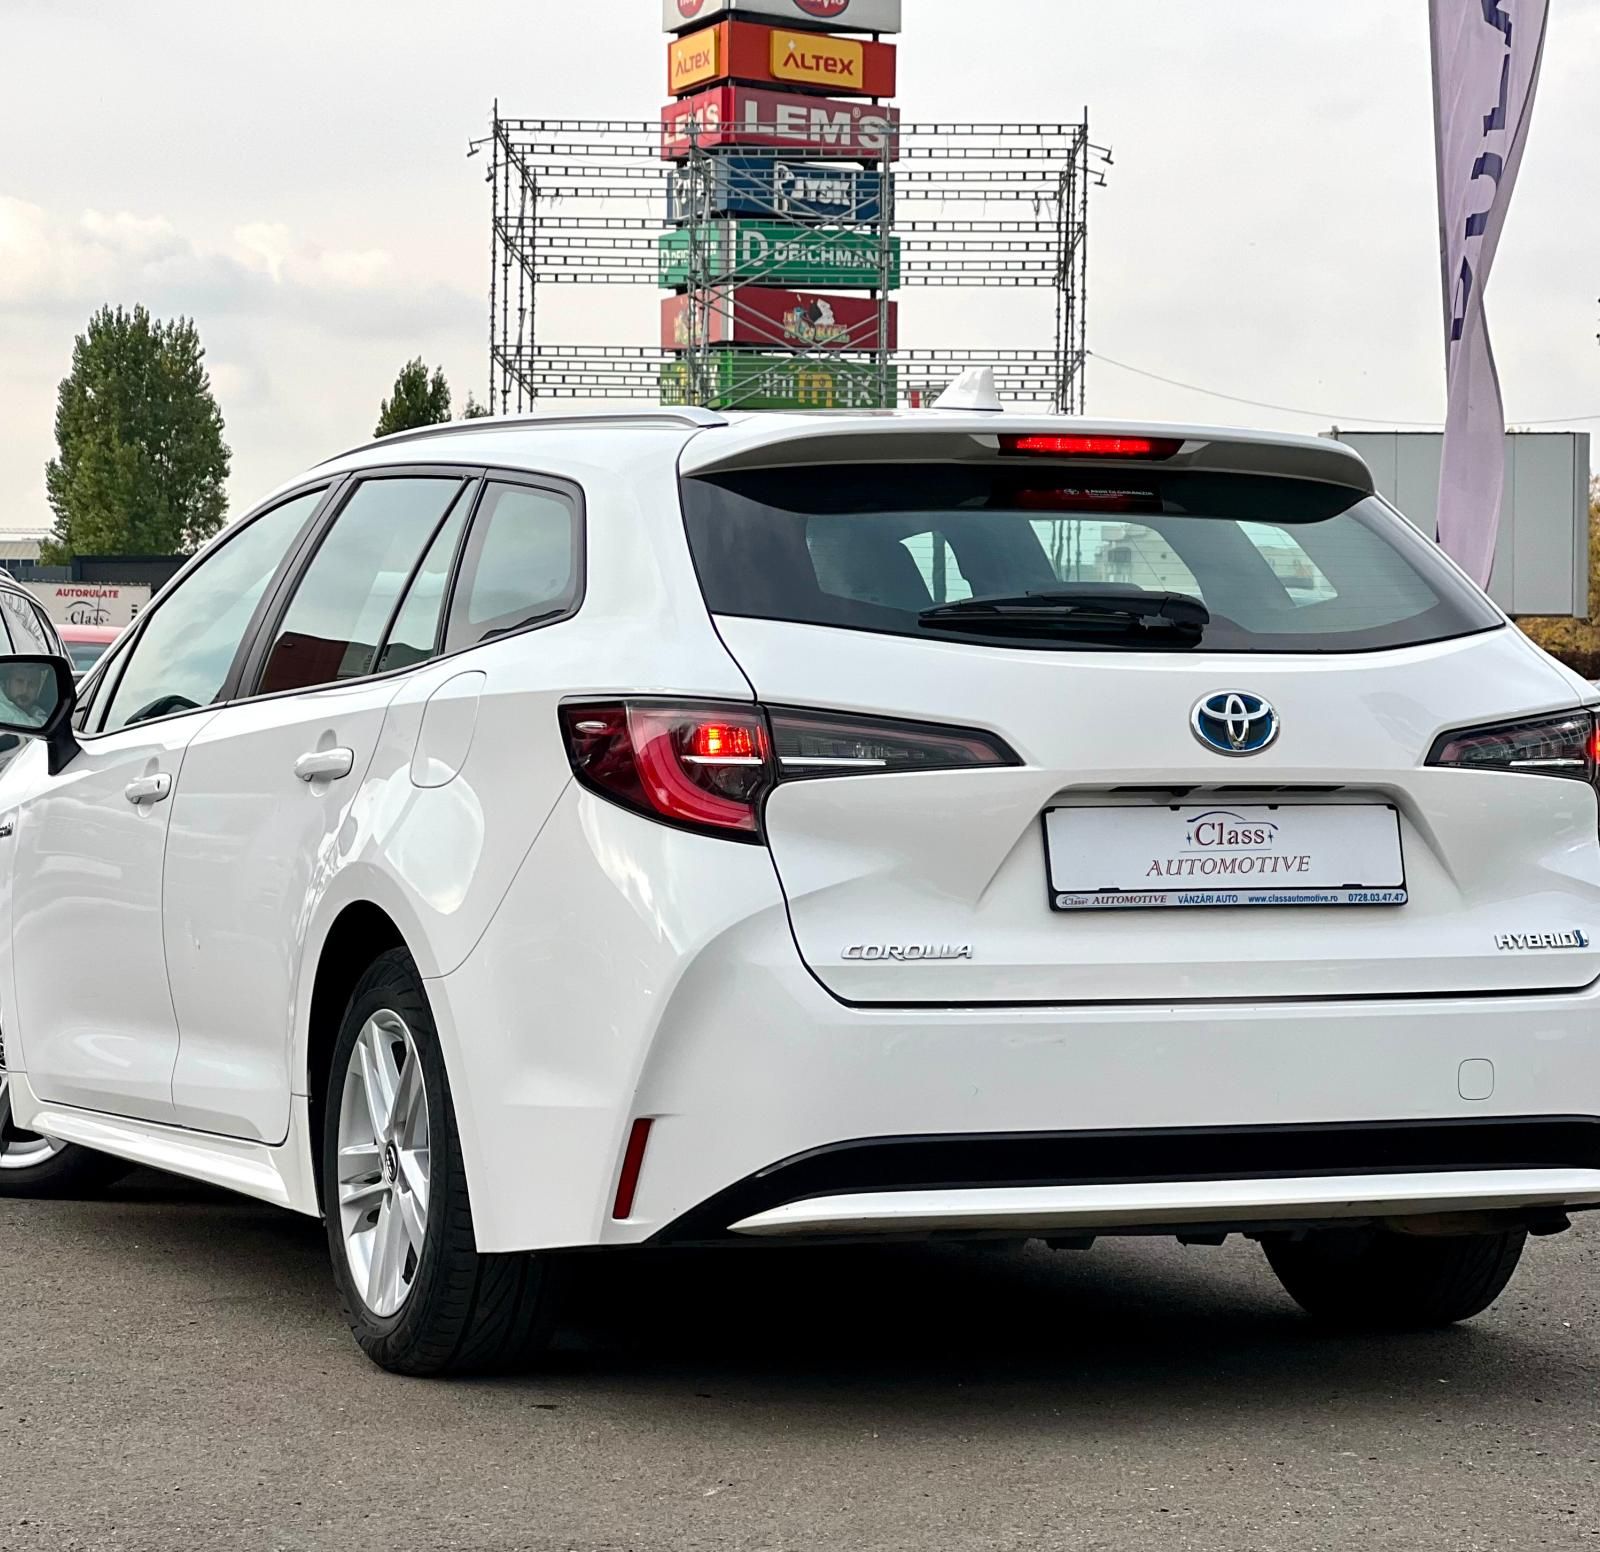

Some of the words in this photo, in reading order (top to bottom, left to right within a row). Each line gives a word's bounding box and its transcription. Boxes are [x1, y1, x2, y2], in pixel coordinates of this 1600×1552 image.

[790, 177, 851, 206] JYSK
[56, 588, 120, 599] AUTORULATE
[70, 610, 104, 625] Class
[1193, 822, 1265, 847] Class
[1146, 855, 1311, 878] AUTOMOTIVE
[1092, 895, 1168, 904] AUTOMOTIVE
[1215, 894, 1239, 904] AUTO
[1248, 894, 1338, 903] www.classautomotive.ro
[1348, 893, 1404, 903] 0728.03.47.47
[1494, 932, 1577, 950] HYBRID
[841, 943, 973, 961] COROLLA
